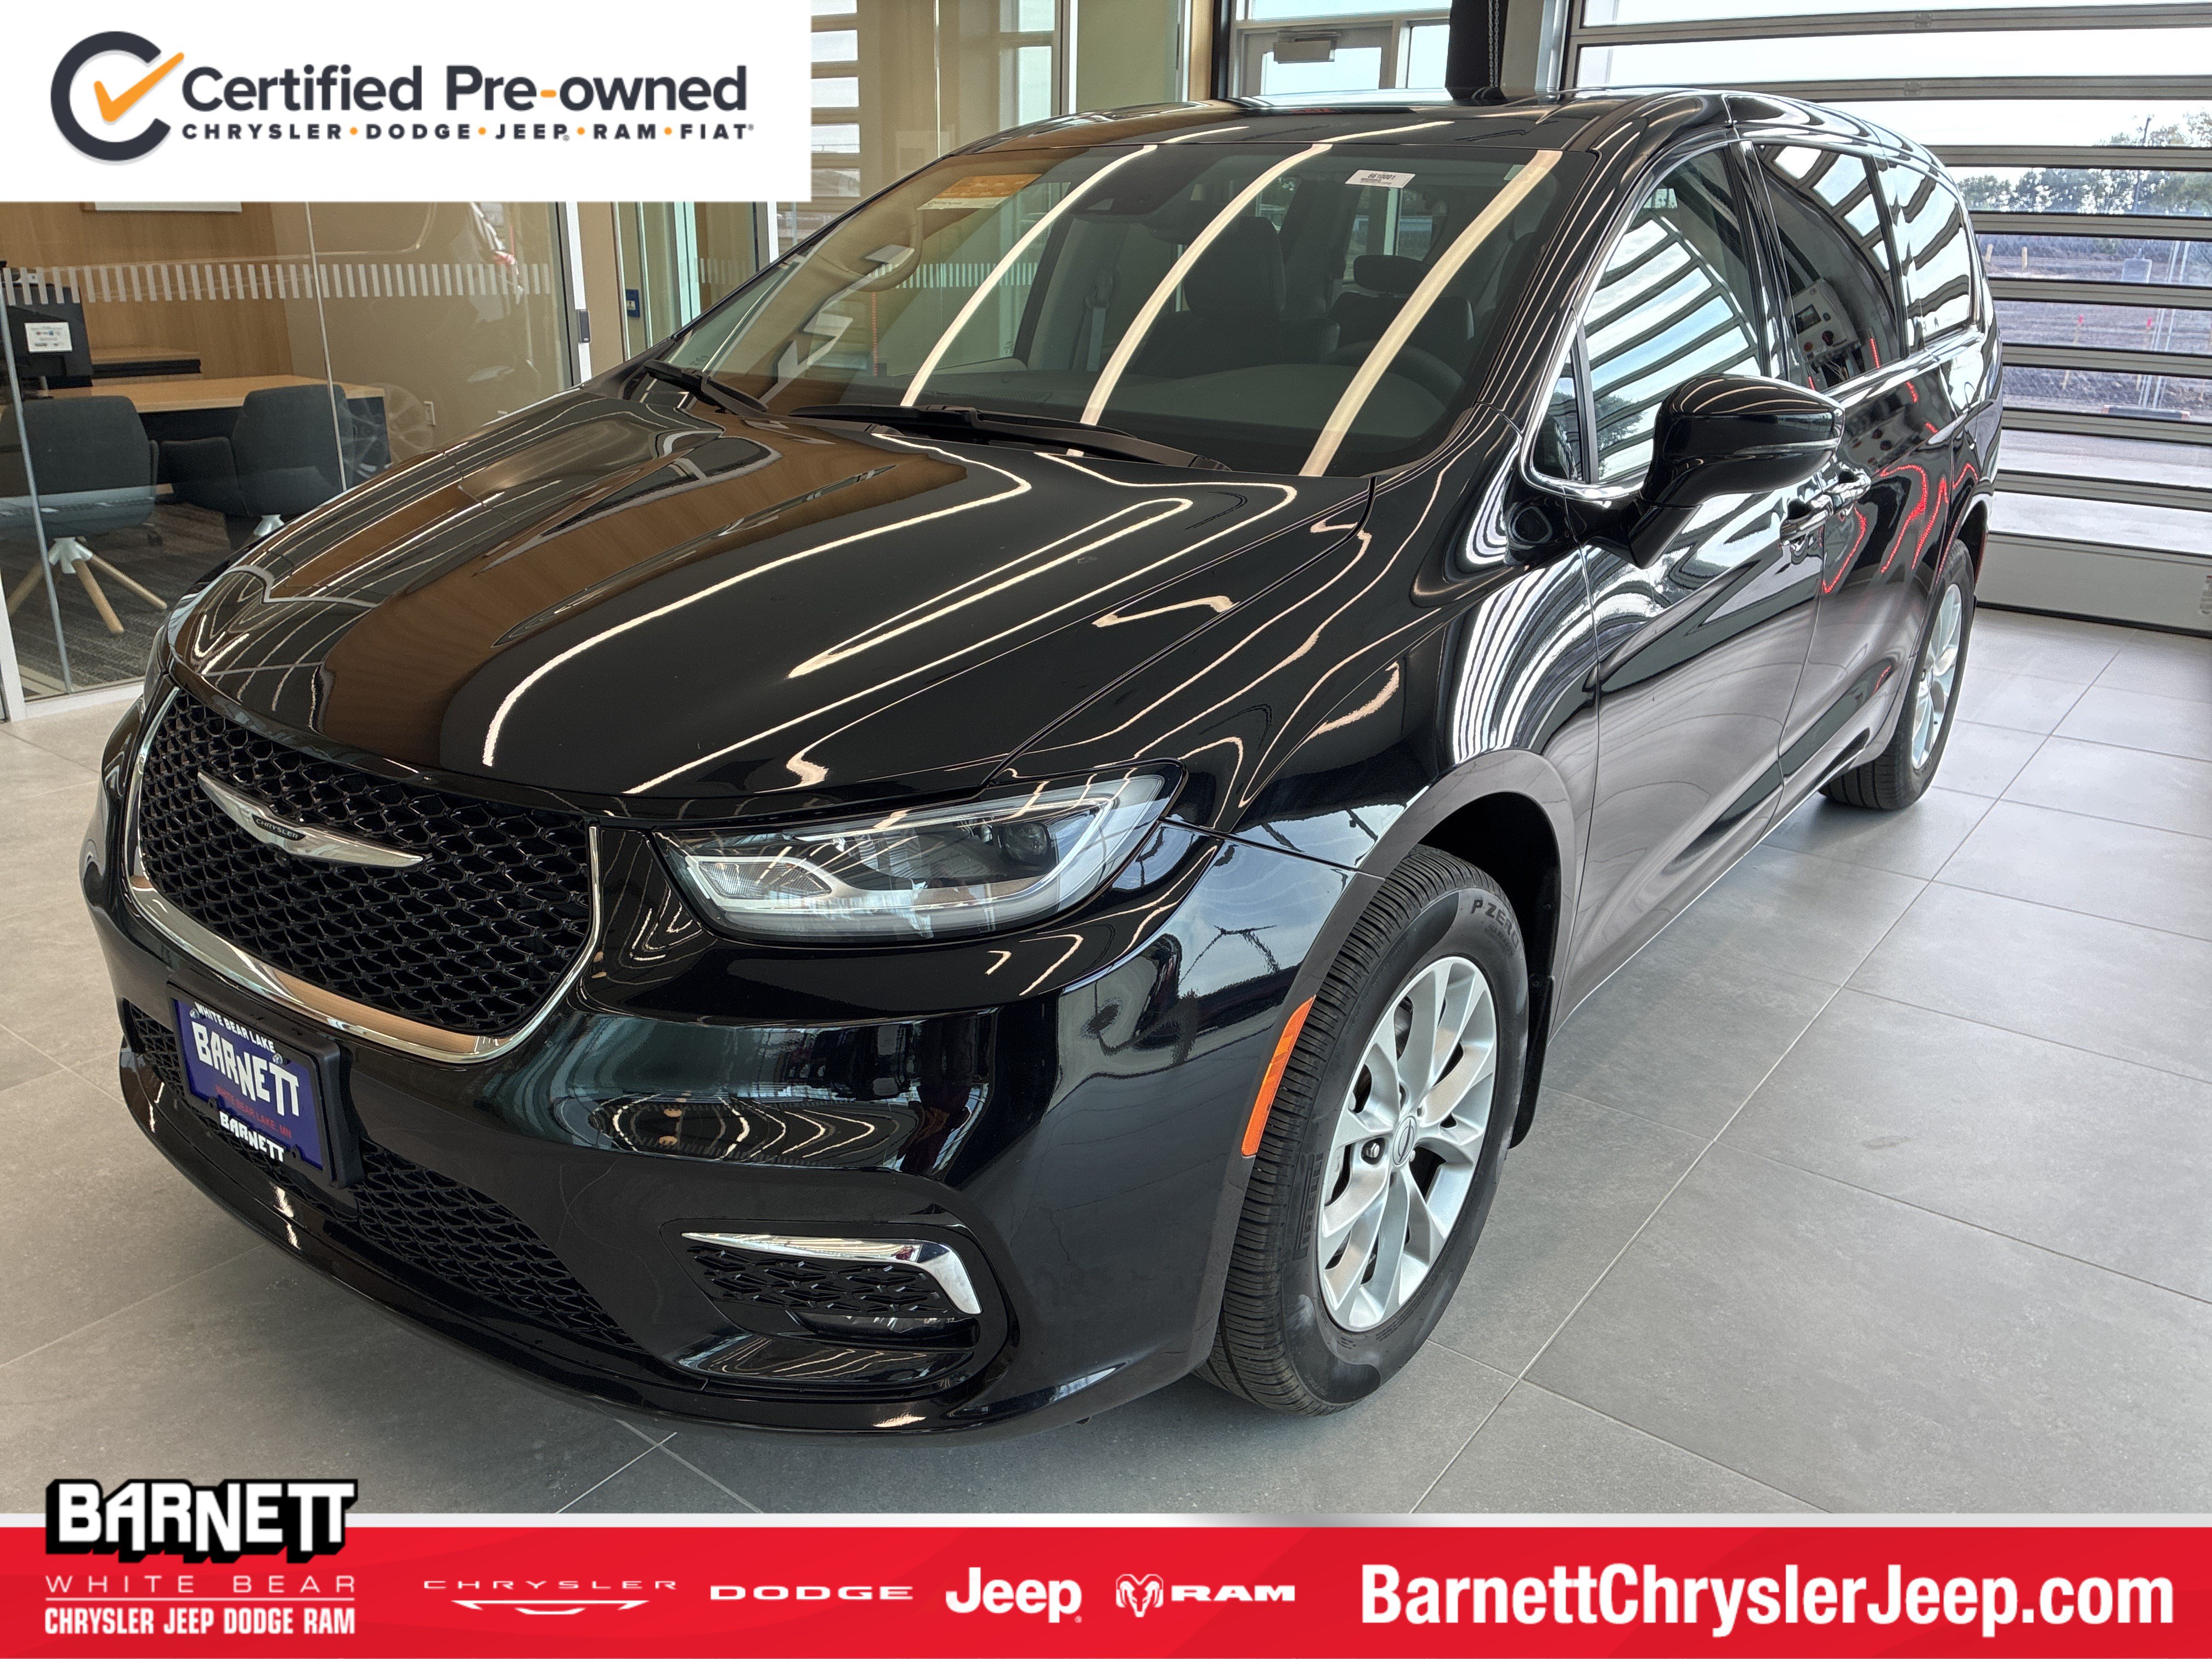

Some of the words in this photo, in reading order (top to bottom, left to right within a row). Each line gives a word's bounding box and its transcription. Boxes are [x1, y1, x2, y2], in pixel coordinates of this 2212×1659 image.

[255, 817, 299, 840] CHRYSLER
[1470, 899, 1483, 915] P
[1485, 902, 1521, 949] ZERO
[194, 1001, 224, 1027] WHITE
[223, 1017, 250, 1041] BEAR
[249, 1030, 276, 1054] LAKE
[191, 1020, 300, 1117] BARNETT
[219, 1110, 284, 1163] BARNETT
[235, 1098, 256, 1117] BEAR
[279, 1124, 292, 1140] MN
[1291, 1153, 1324, 1261] PIRELLI
